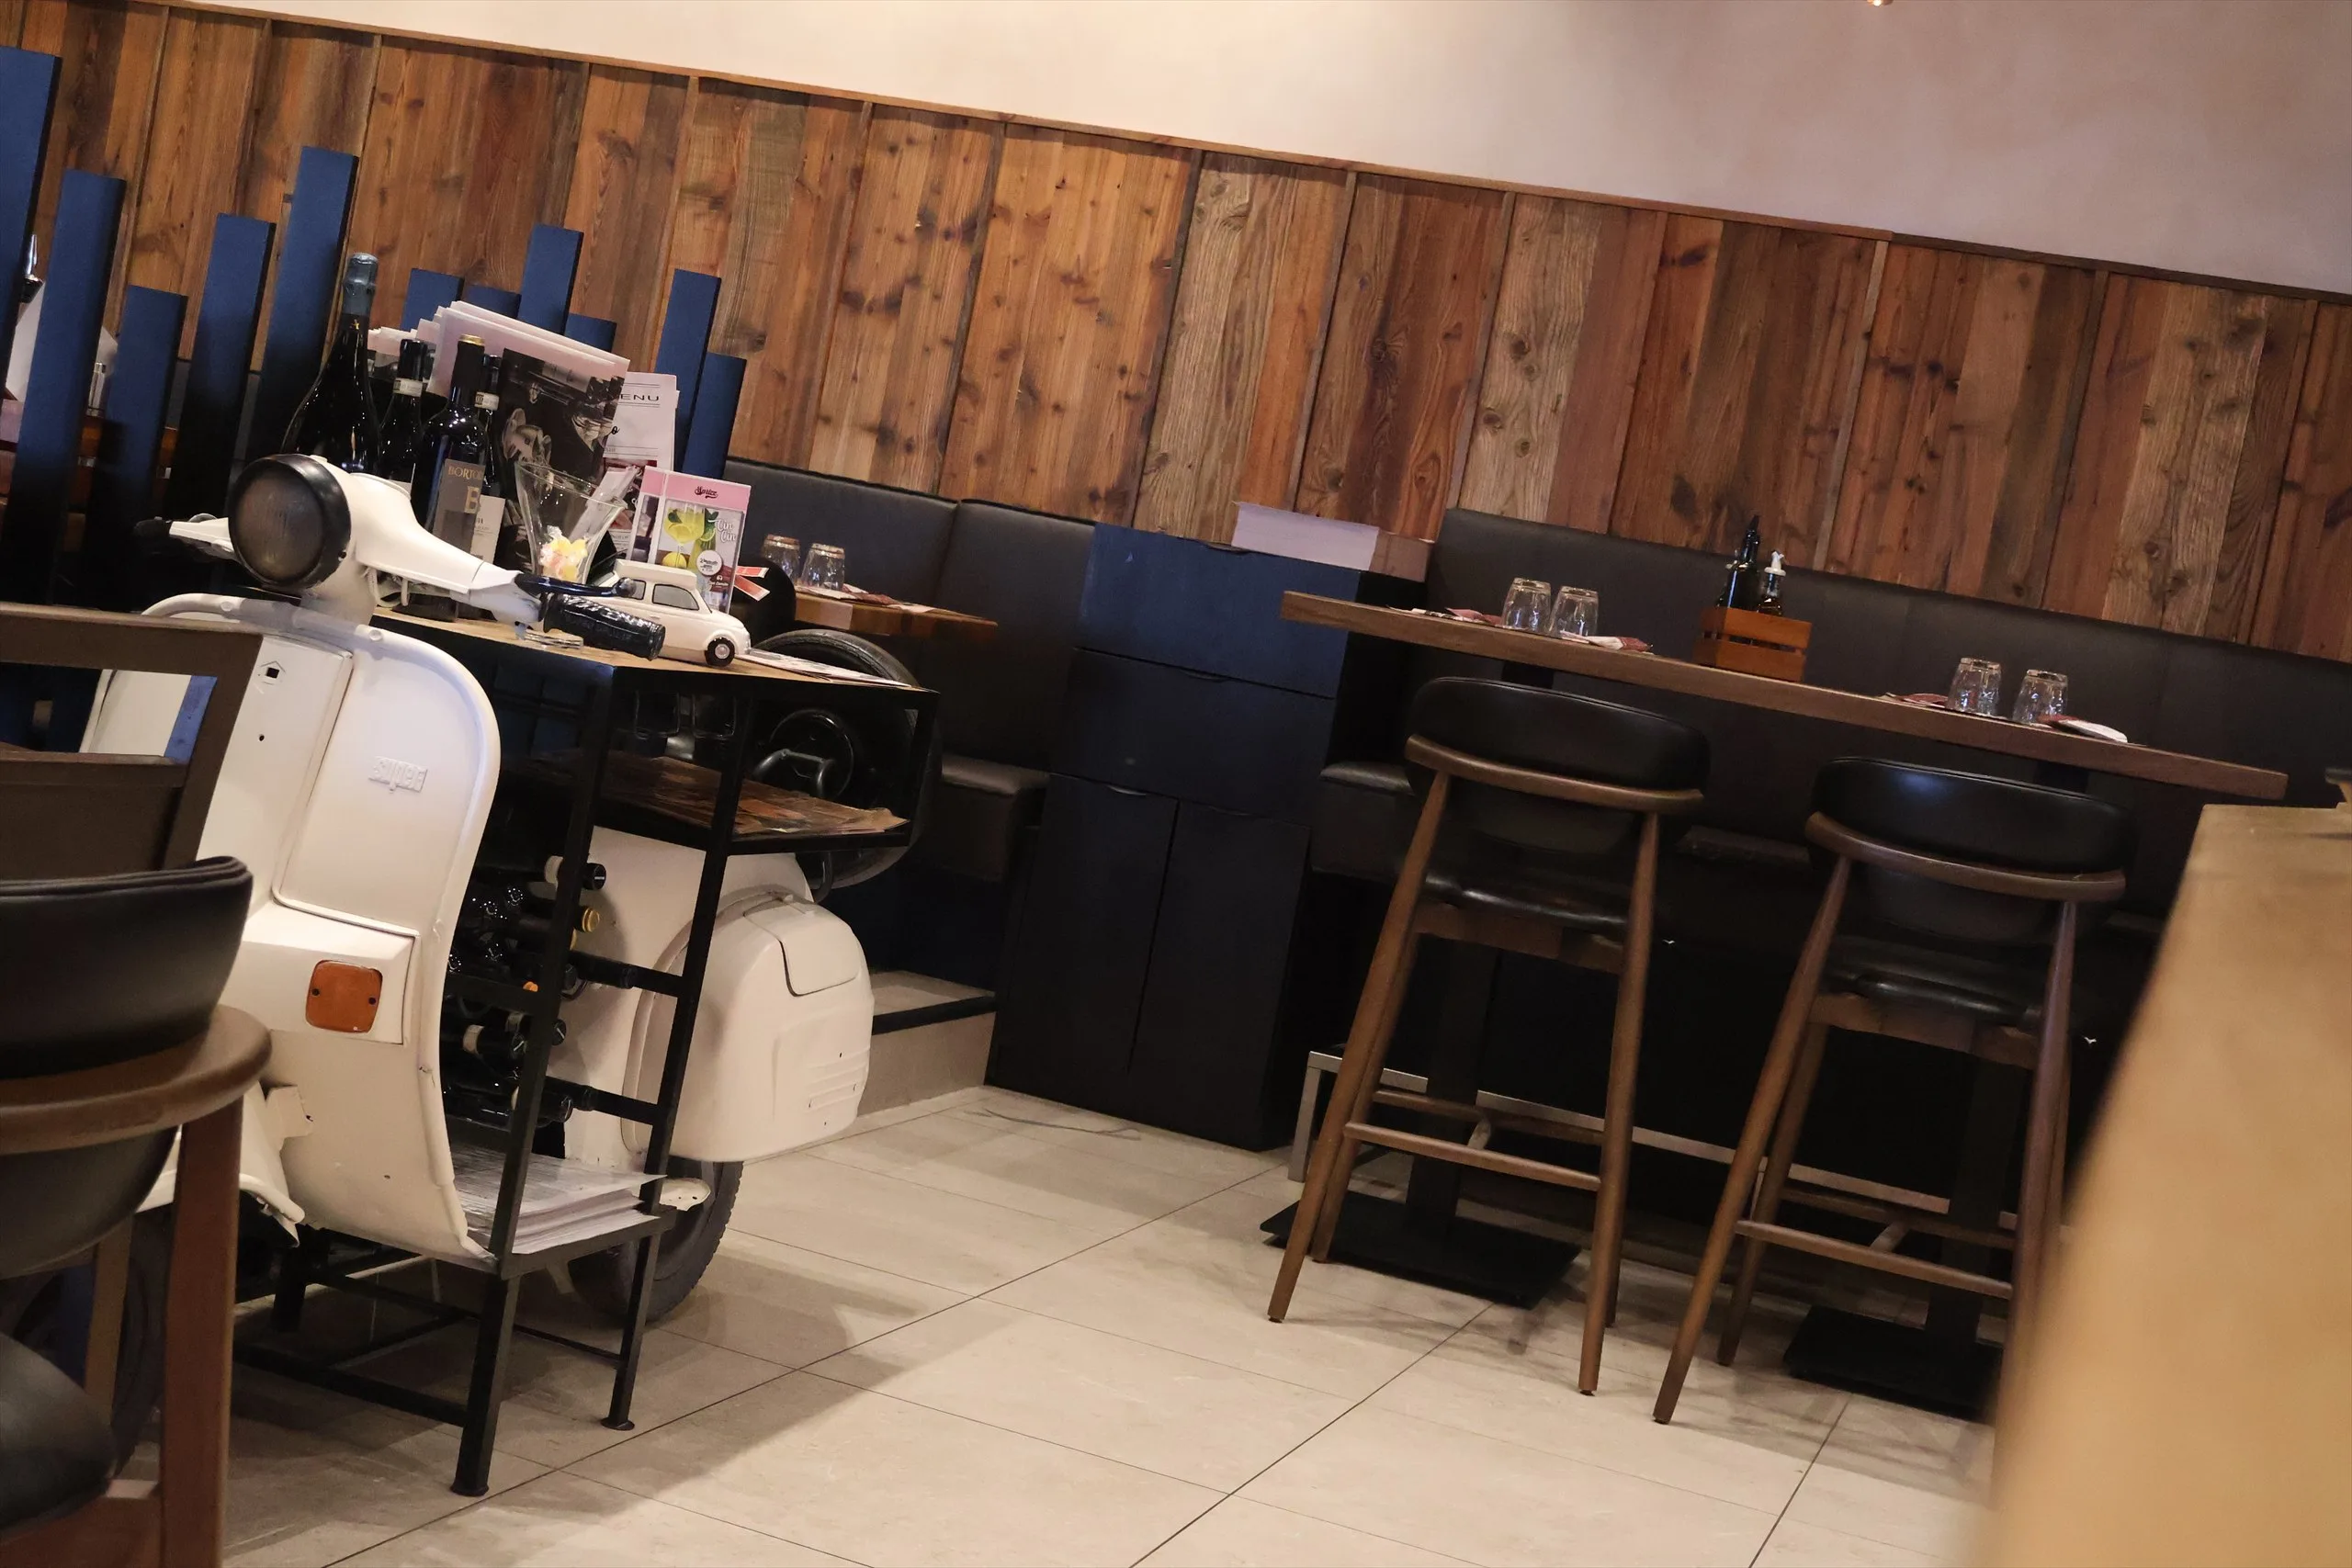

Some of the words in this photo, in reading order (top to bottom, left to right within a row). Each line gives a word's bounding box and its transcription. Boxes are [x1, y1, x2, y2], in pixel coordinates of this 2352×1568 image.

[620, 393, 660, 401] ENU
[711, 518, 733, 532] Cin
[720, 530, 736, 543] Cin
